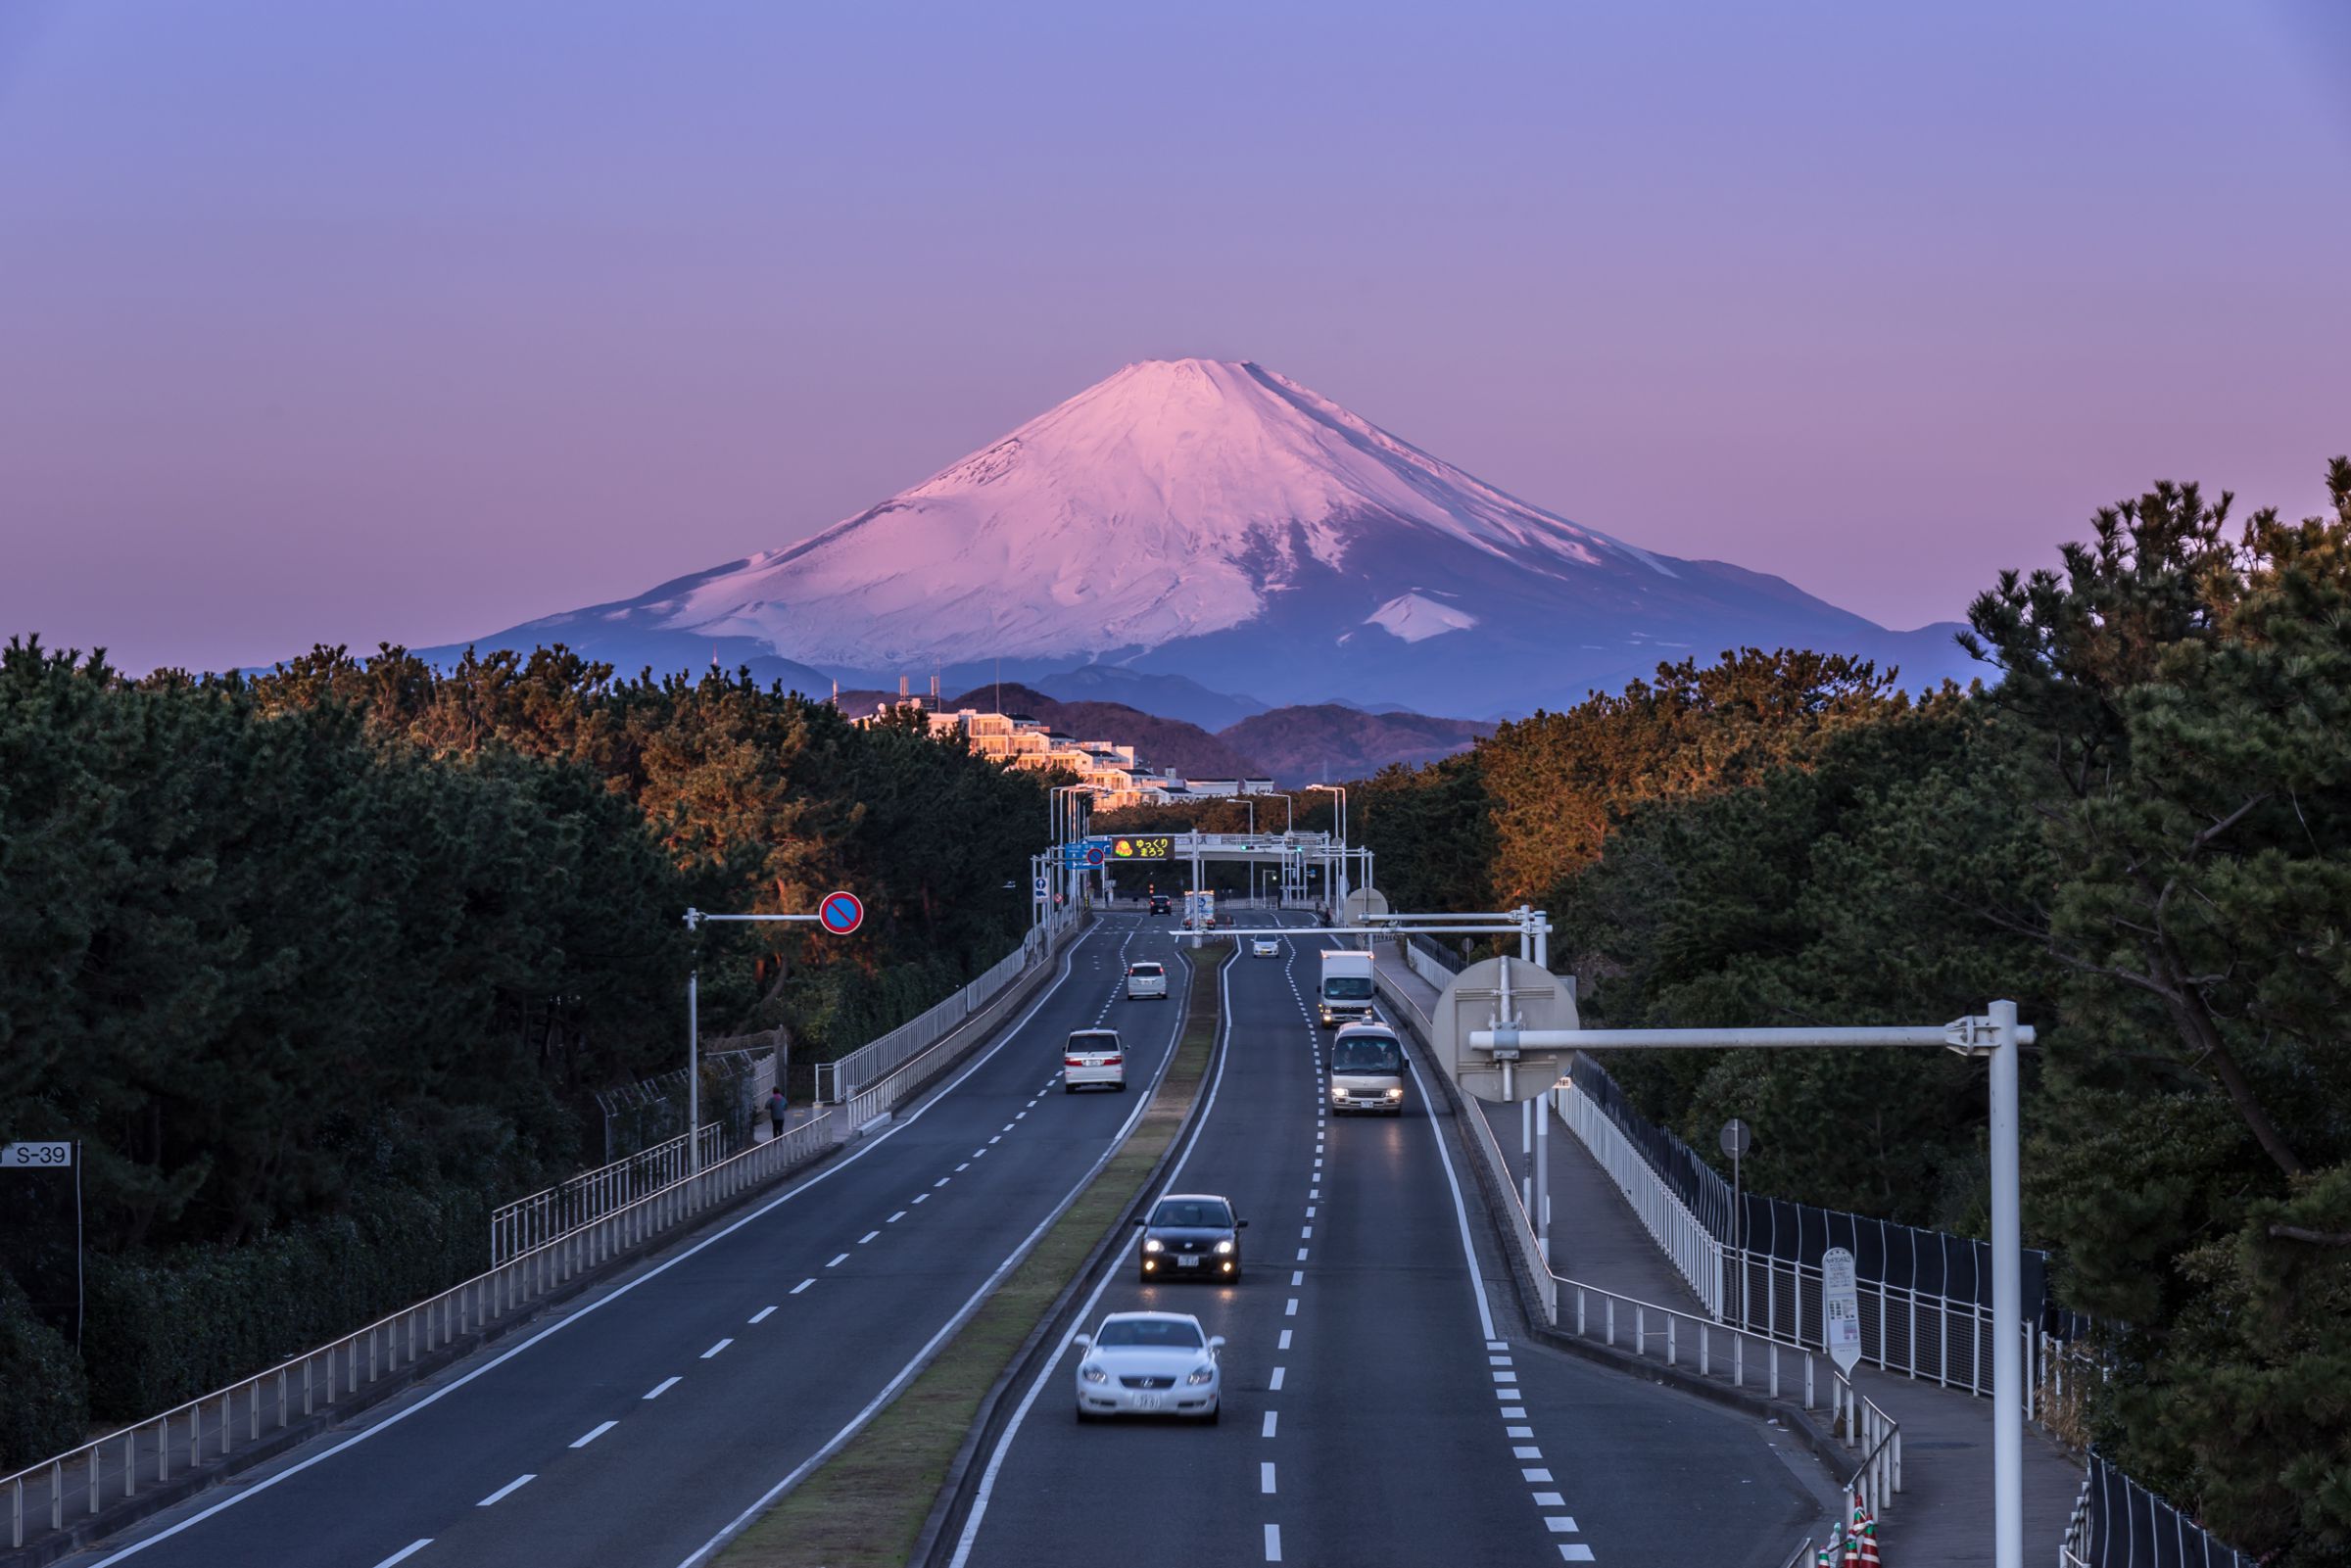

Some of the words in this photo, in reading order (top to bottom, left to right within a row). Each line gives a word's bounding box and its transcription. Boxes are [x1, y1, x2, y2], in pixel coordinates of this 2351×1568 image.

[1136, 838, 1168, 848] ゆっくり
[17, 1147, 65, 1164] S-39
